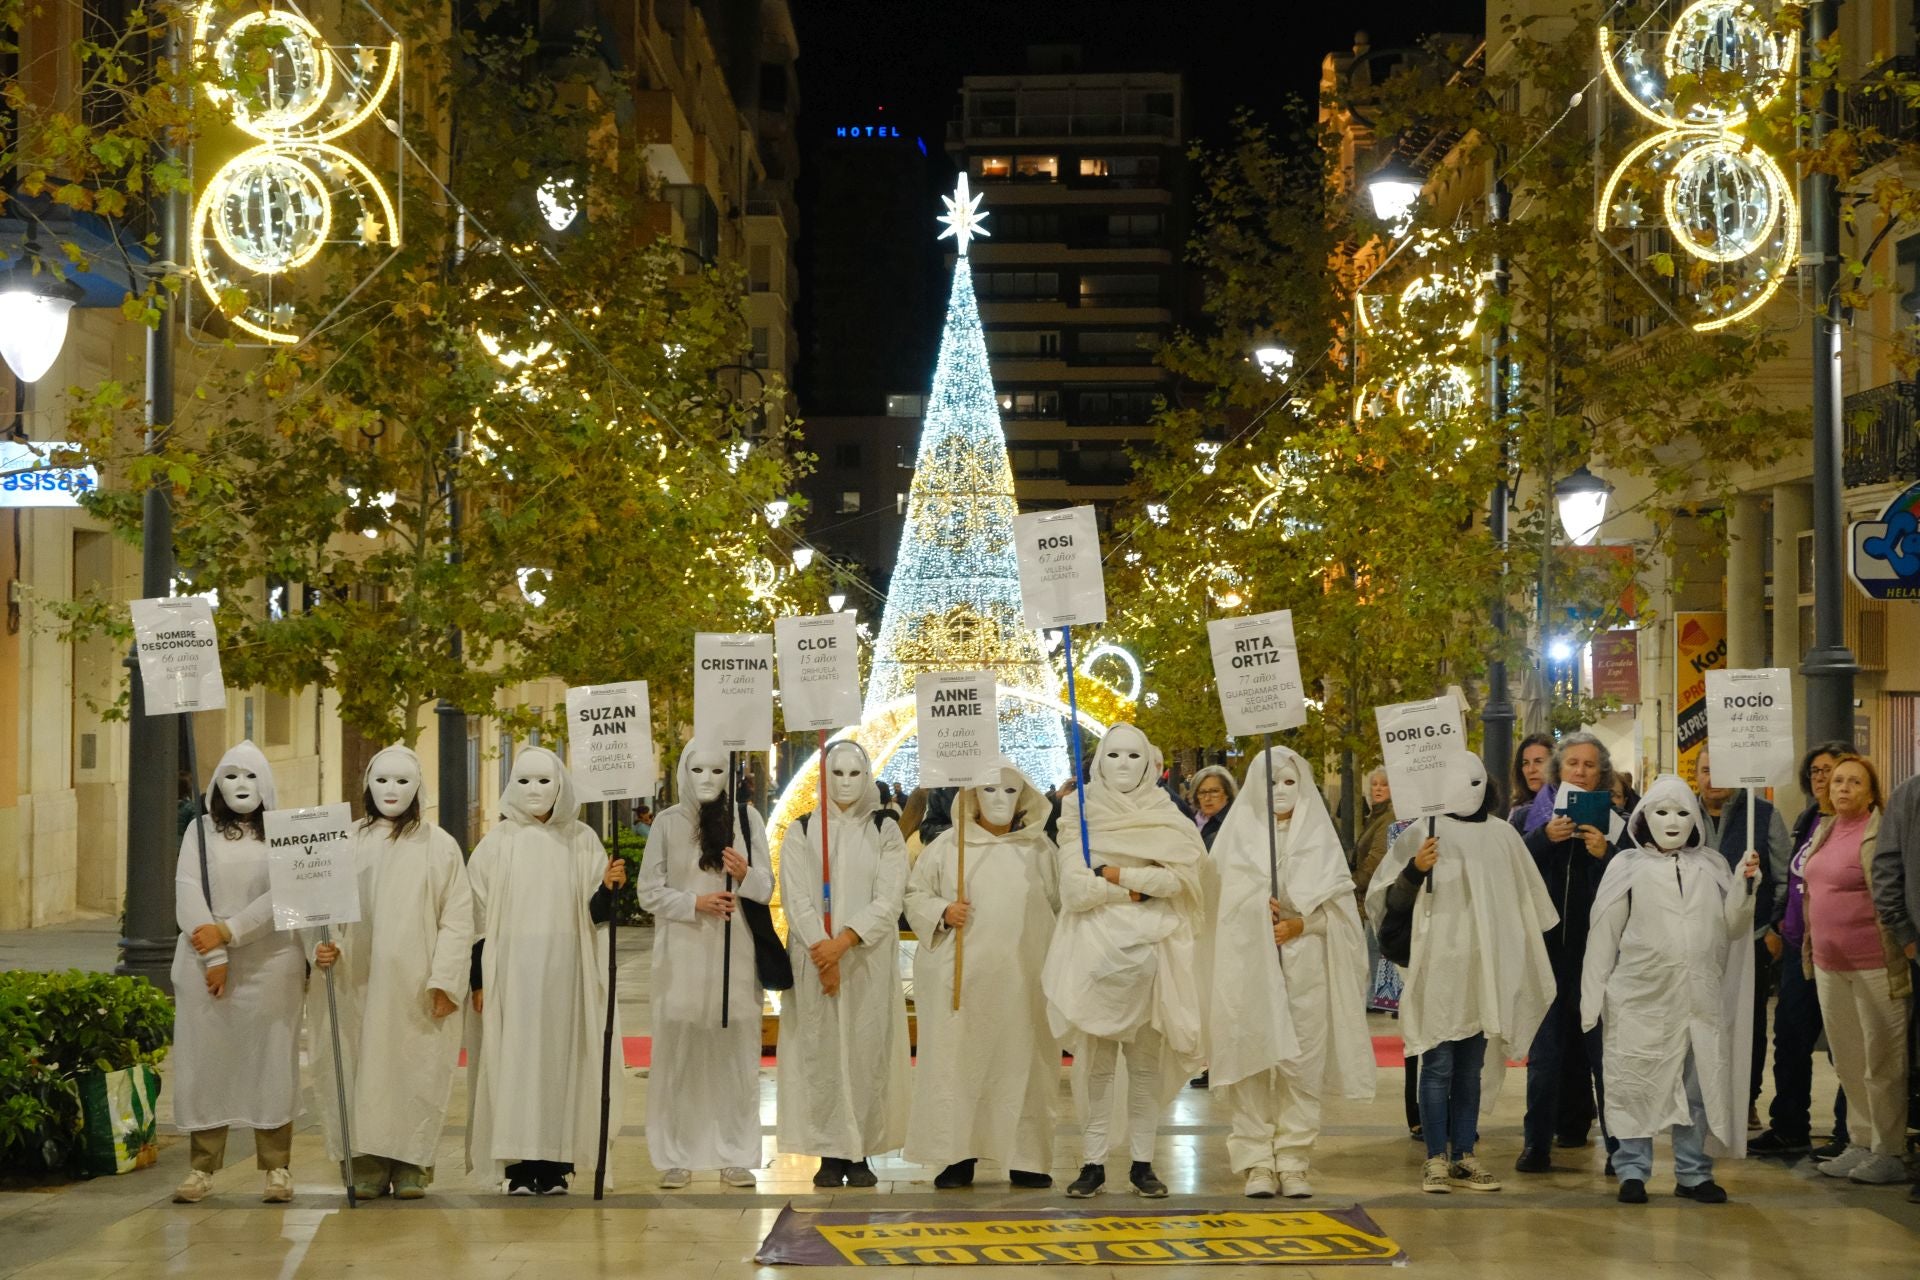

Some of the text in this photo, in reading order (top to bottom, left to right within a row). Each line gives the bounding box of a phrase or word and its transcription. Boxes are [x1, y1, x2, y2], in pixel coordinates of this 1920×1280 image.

[836, 126, 900, 137] HOTEL
[3, 473, 73, 491] asisa
[1038, 535, 1073, 550] ROSI
[1039, 552, 1076, 564] 67 años
[1886, 588, 1920, 597] HELA
[156, 630, 197, 641] NOMBRE
[141, 638, 213, 652] DESCONOCIDO
[797, 637, 837, 651] CLOE
[1235, 636, 1274, 654] RITA
[162, 652, 199, 664] 66 años
[800, 654, 838, 665] 15 años
[1231, 650, 1280, 669] ORTIZ
[701, 658, 768, 671] CRISTINA
[719, 674, 755, 684] 37 años
[1239, 673, 1276, 685] 77 años
[721, 687, 755, 695] ALICANTE
[934, 688, 978, 703] ANNE
[1225, 682, 1297, 699] GUARDAMAR DEL
[1246, 695, 1279, 705] SEGURA
[1724, 692, 1773, 708] ROCÍO
[580, 705, 636, 722] SUZAN
[931, 703, 982, 718] MARIE
[1731, 712, 1769, 722] 44 años
[592, 721, 626, 736] ANN
[1678, 708, 1707, 742] EXPRE
[937, 728, 975, 738] 63 años
[1386, 723, 1456, 743] DORI G.G.
[591, 741, 628, 751] 80 años
[938, 740, 979, 750] ORIHUELA
[1404, 742, 1442, 754] 27 años
[591, 753, 633, 763] ORIHUELA
[270, 830, 348, 848] MARGARITA
[304, 846, 318, 855] V.
[292, 858, 332, 871] 36 años
[296, 870, 332, 880] ALICANTE
[837, 1217, 1312, 1239] EL MACHISMO MATA
